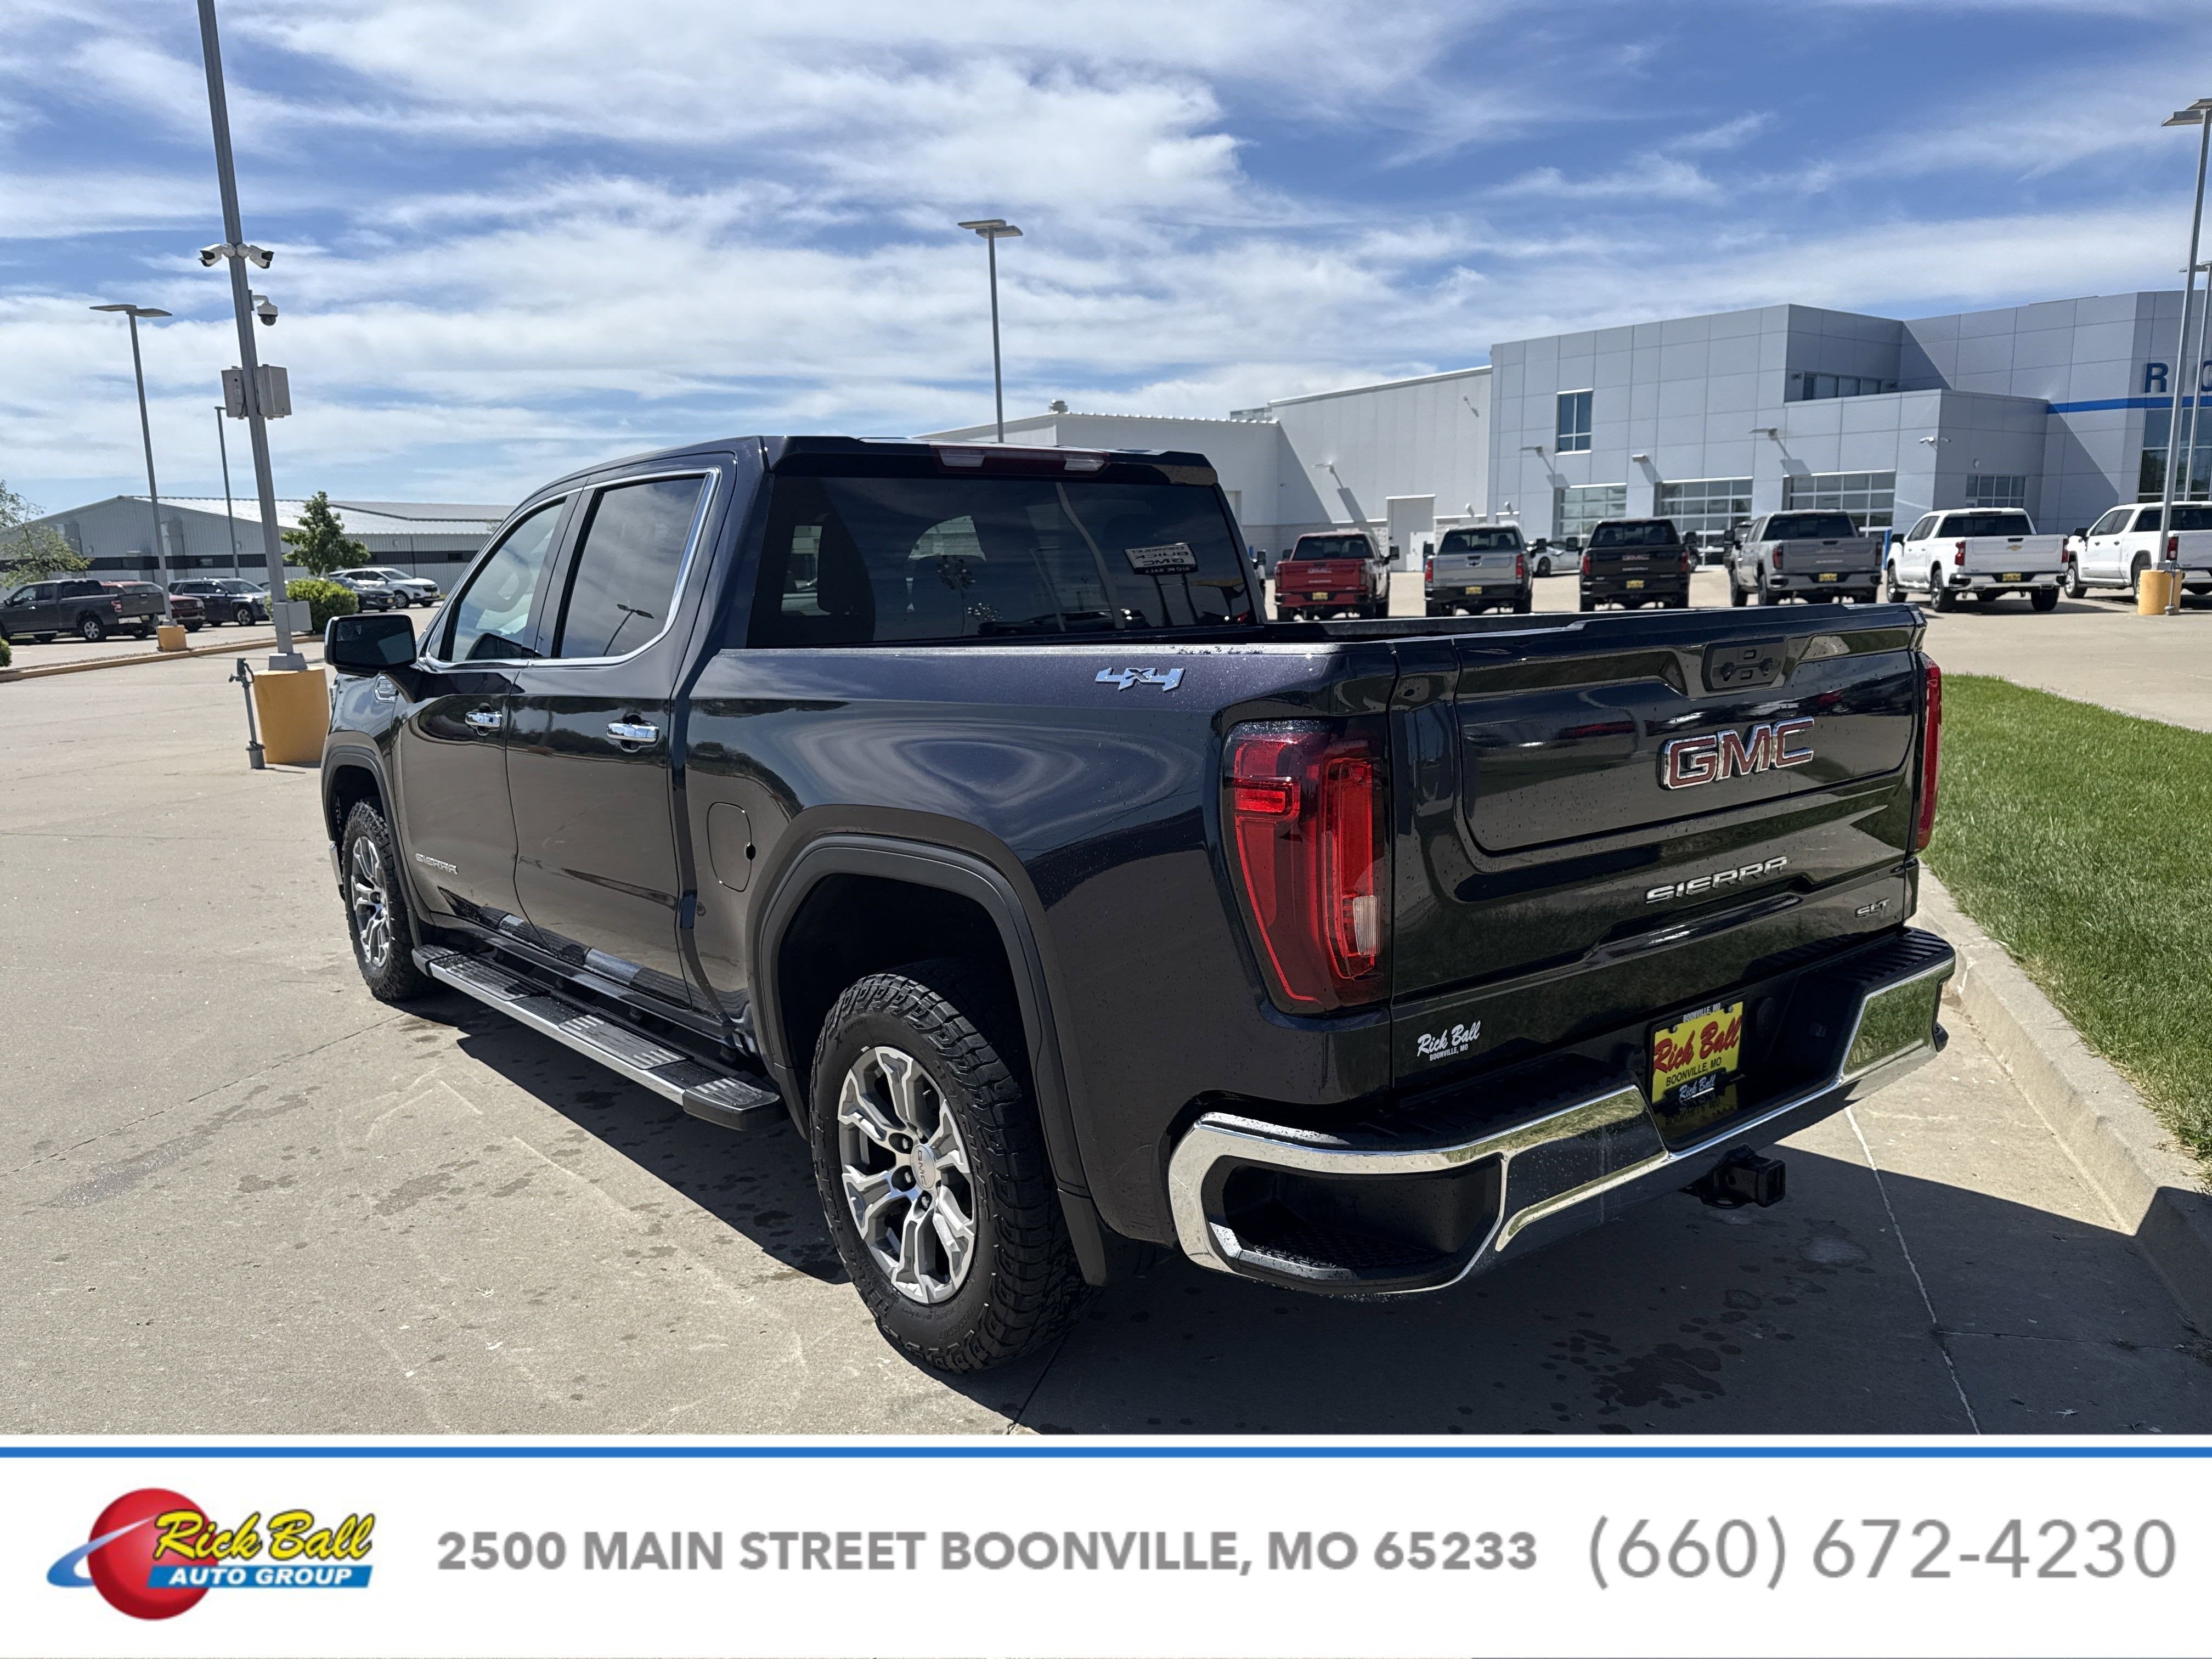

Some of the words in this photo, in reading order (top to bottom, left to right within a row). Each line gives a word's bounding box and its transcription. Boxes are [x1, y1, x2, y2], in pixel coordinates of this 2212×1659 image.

[1660, 716, 1815, 790] GMC
[415, 853, 458, 875] SIERRA
[1646, 856, 1788, 904] SIERRA
[1855, 898, 1891, 917] SLT
[1683, 1007, 1711, 1023] BOONVILLE,
[1712, 1002, 1722, 1013] MO
[1417, 1029, 1448, 1057] Rick
[1451, 1020, 1481, 1046] Ball
[1429, 1047, 1459, 1062] BOONVILLE,
[1460, 1043, 1469, 1052] MO
[1654, 1030, 1696, 1074] Rick
[1699, 1015, 1742, 1059] Ball
[1666, 1063, 1708, 1087] BOONVILLE,
[1710, 1057, 1722, 1068] MO
[1679, 1084, 1697, 1098] Rick
[1699, 1073, 1717, 1091] Ball
[918, 1149, 927, 1186] GMC
